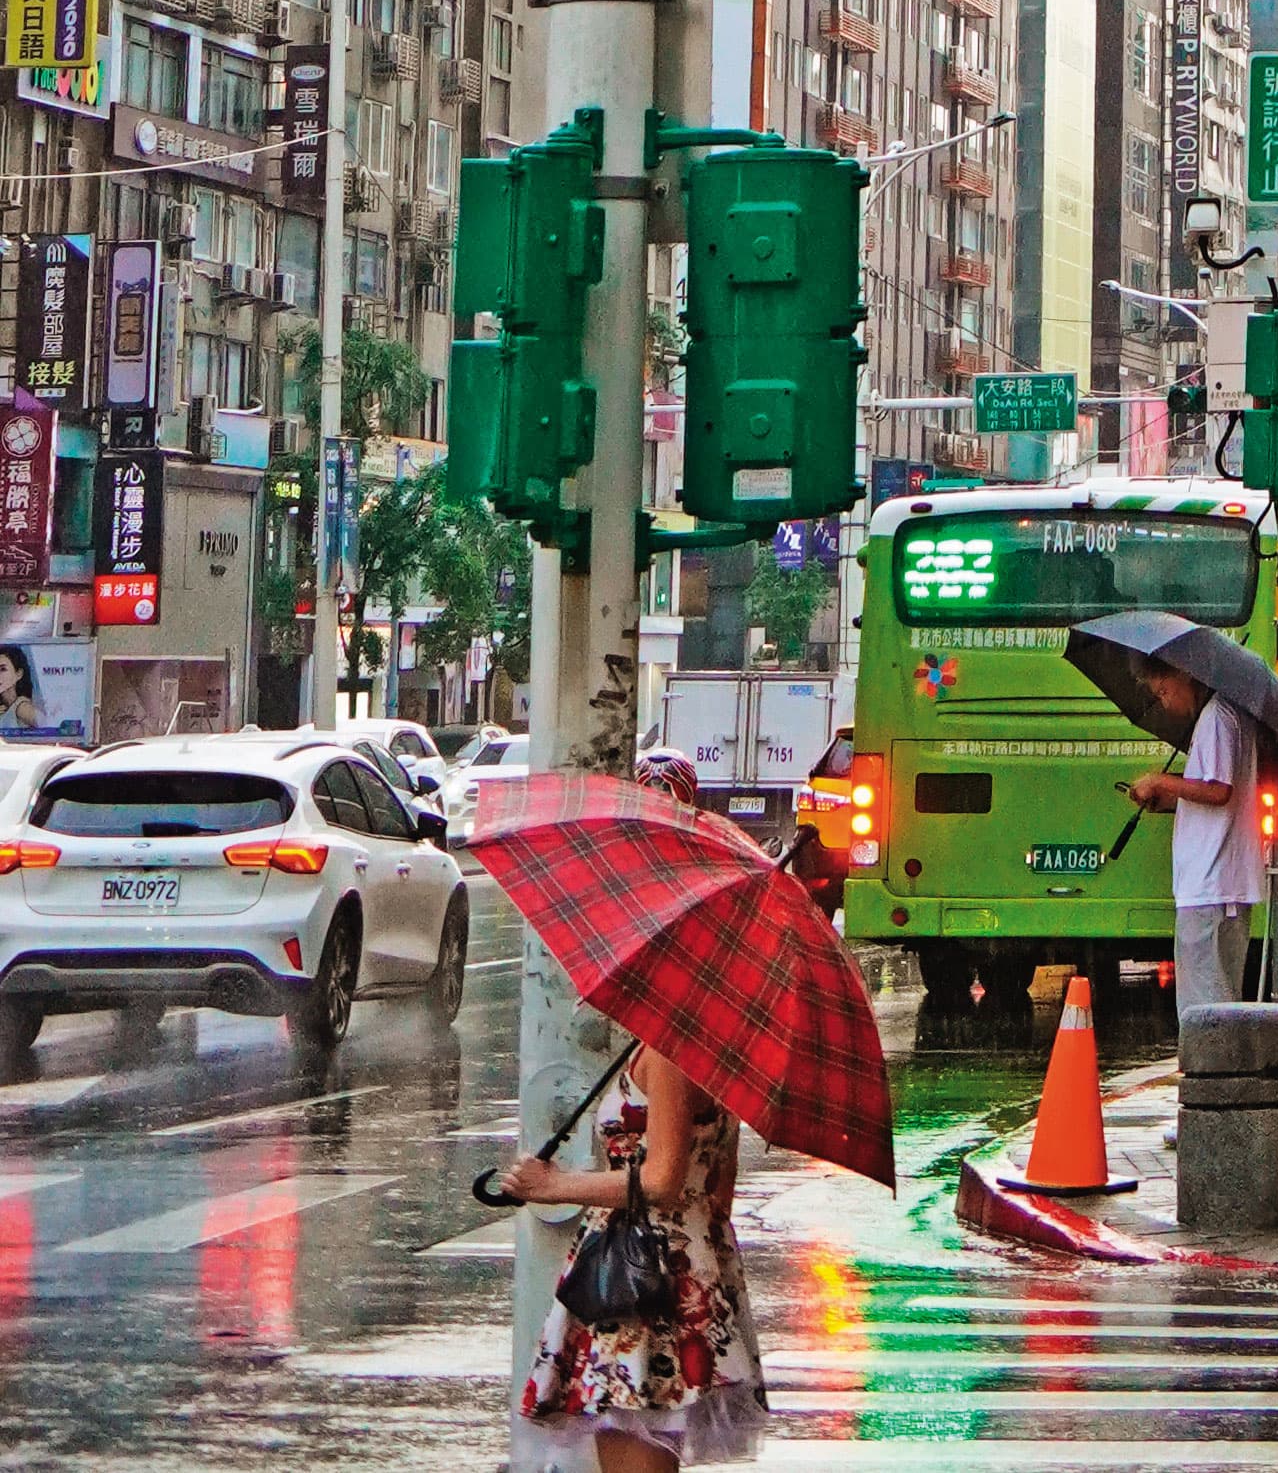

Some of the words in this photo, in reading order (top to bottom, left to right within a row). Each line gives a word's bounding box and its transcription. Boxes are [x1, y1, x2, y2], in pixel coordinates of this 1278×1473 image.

[27, 360, 77, 386] 接髮
[984, 378, 1066, 398] 大安路一段
[120, 462, 146, 559] 心靈漫步
[1043, 522, 1118, 554] FAA-068
[767, 747, 794, 763] 7151
[102, 880, 178, 901] BNZ-0972
